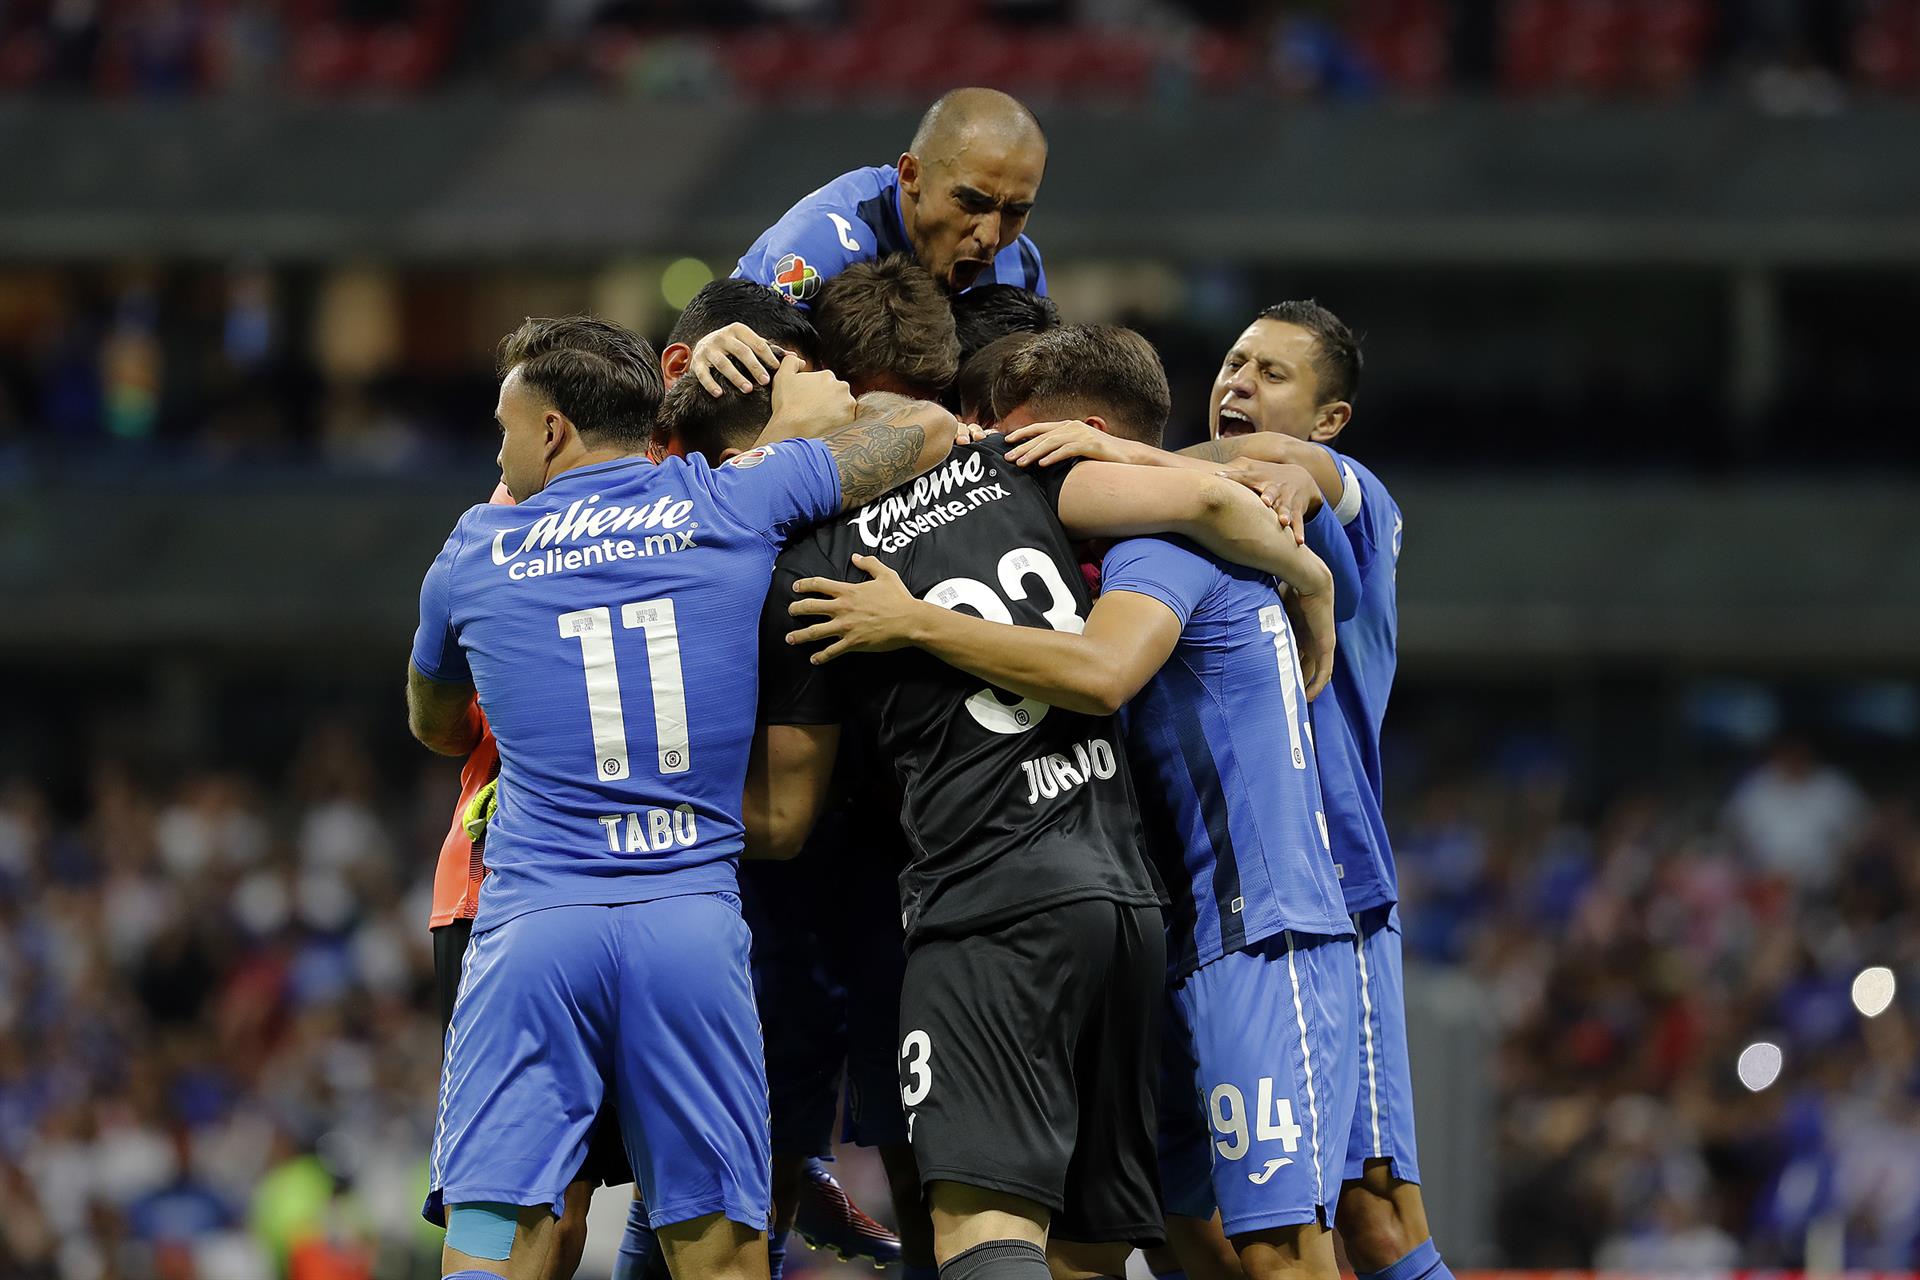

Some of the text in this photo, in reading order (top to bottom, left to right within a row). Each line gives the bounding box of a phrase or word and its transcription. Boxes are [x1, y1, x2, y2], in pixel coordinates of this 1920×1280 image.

[491, 494, 694, 566] Caliente
[508, 529, 698, 580] caliente.mx
[558, 598, 690, 782] 11
[1021, 739, 1117, 805] JURAO
[898, 1029, 932, 1107] 3
[1200, 1077, 1303, 1161] 94
